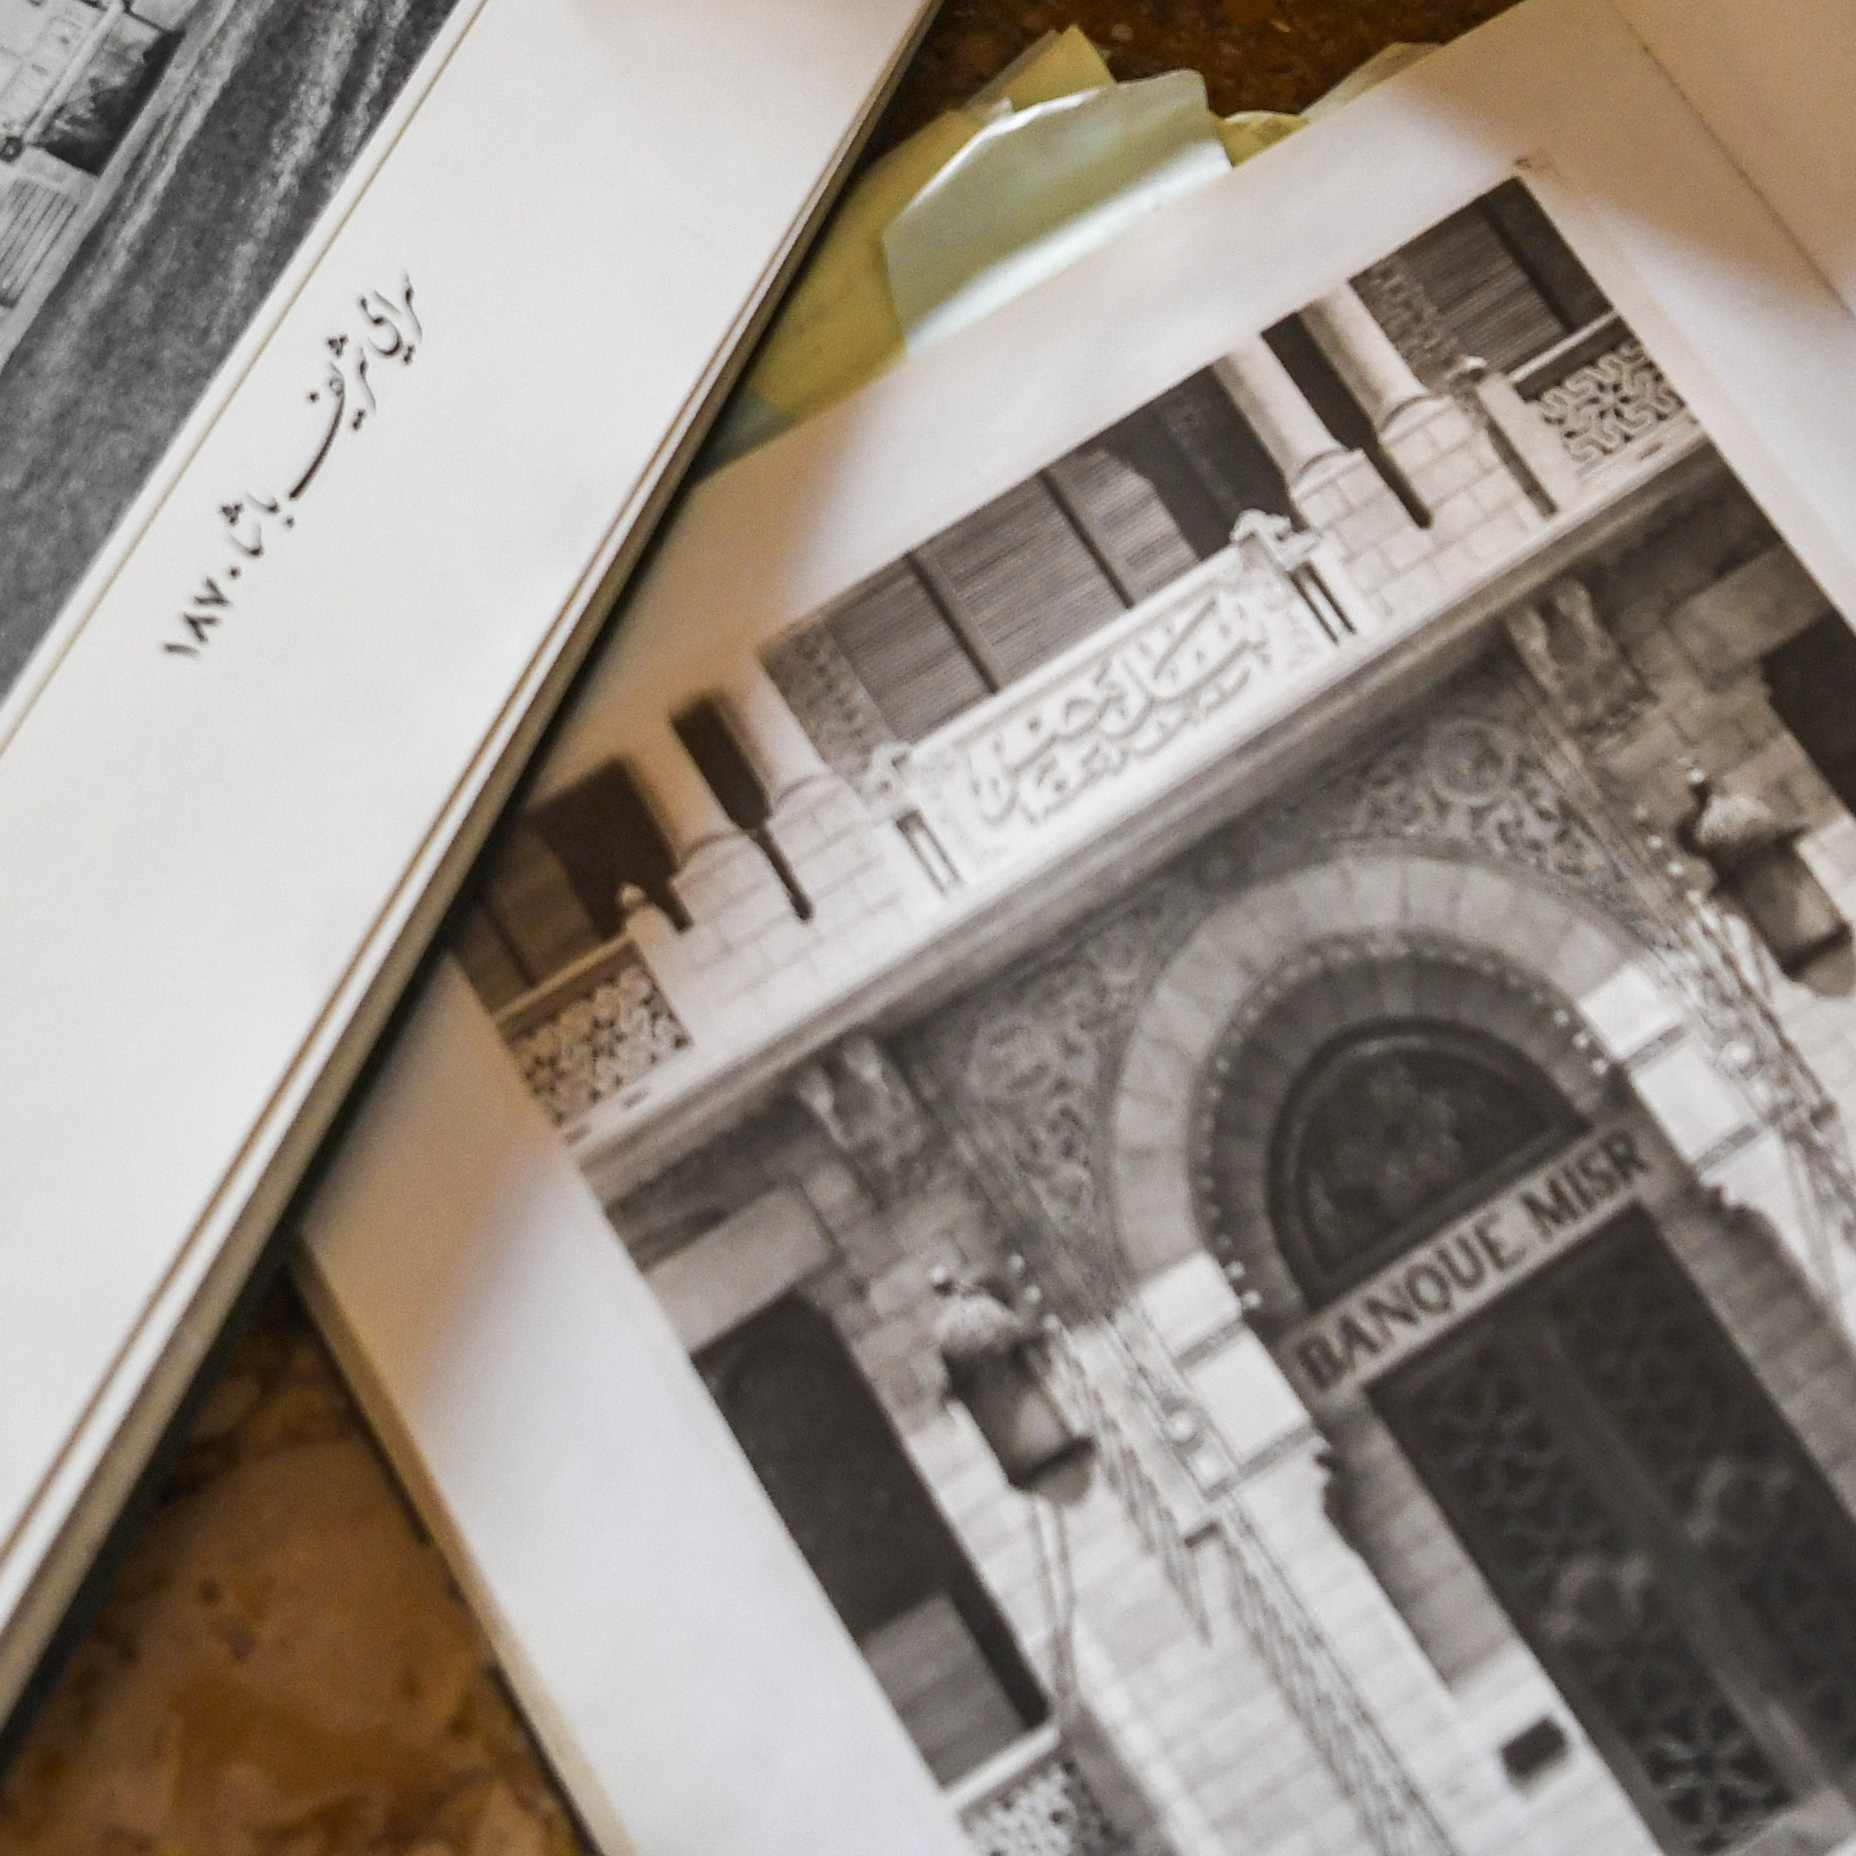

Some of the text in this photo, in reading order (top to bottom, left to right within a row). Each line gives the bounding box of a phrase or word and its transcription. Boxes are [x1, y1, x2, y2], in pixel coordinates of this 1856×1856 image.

[161, 564, 243, 659] ١٨٧٠
[1294, 1126, 1650, 1393] BANQUE MISR
